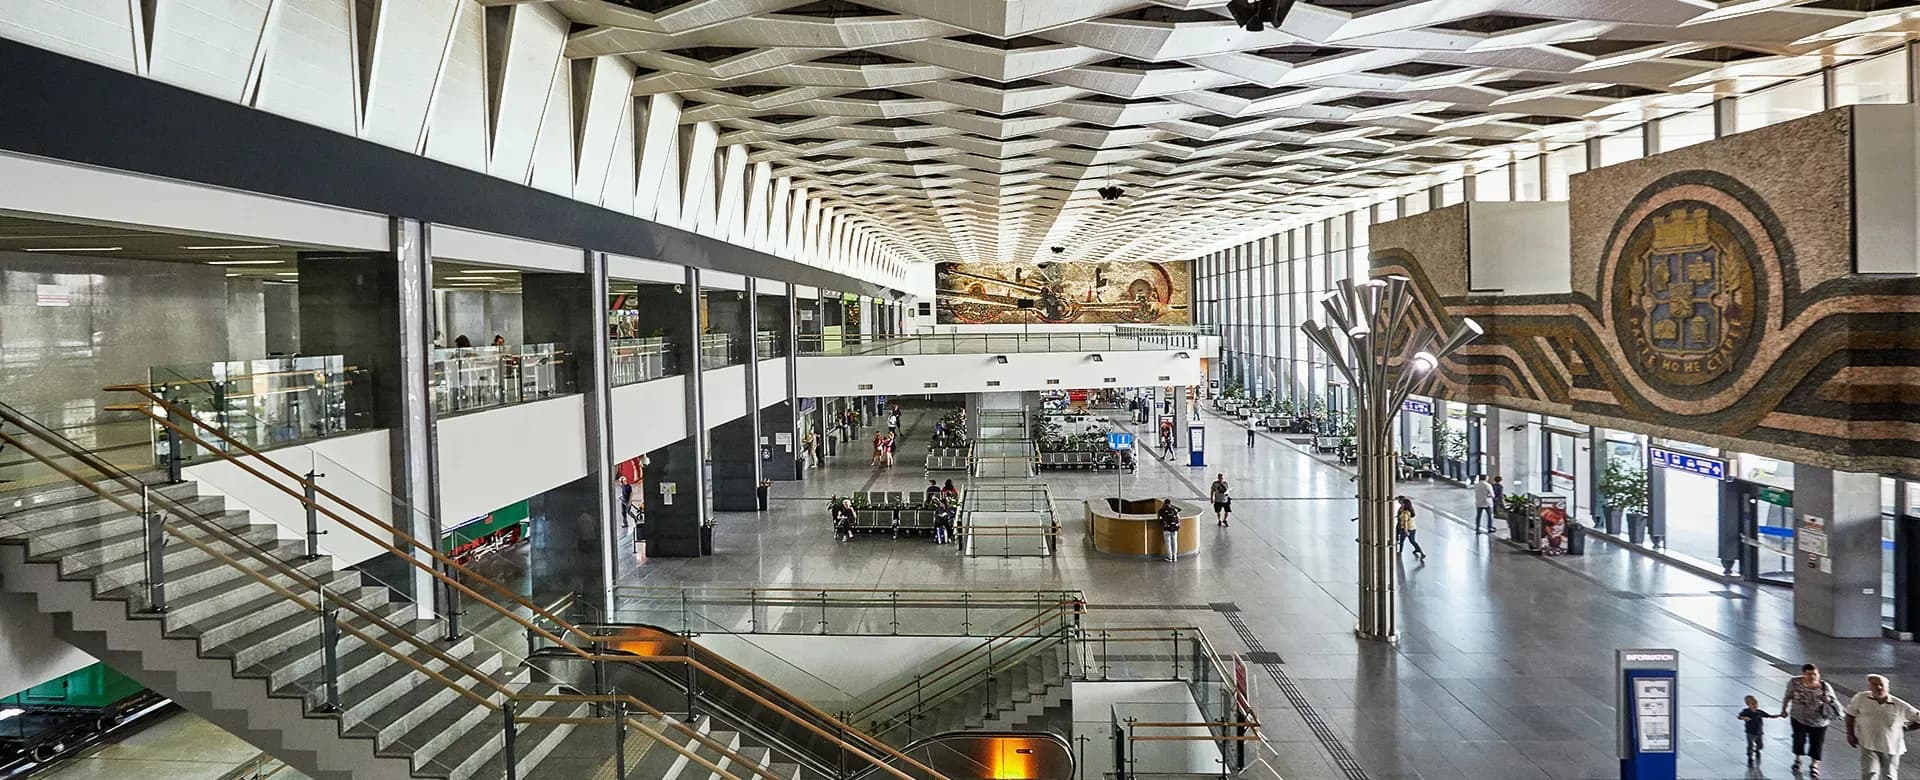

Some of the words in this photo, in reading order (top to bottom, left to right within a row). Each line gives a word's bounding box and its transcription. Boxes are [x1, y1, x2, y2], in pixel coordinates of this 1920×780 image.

[1662, 360, 1680, 371] НО
[1684, 361, 1701, 372] НЕ
[1626, 654, 1674, 662] INFORMATION
